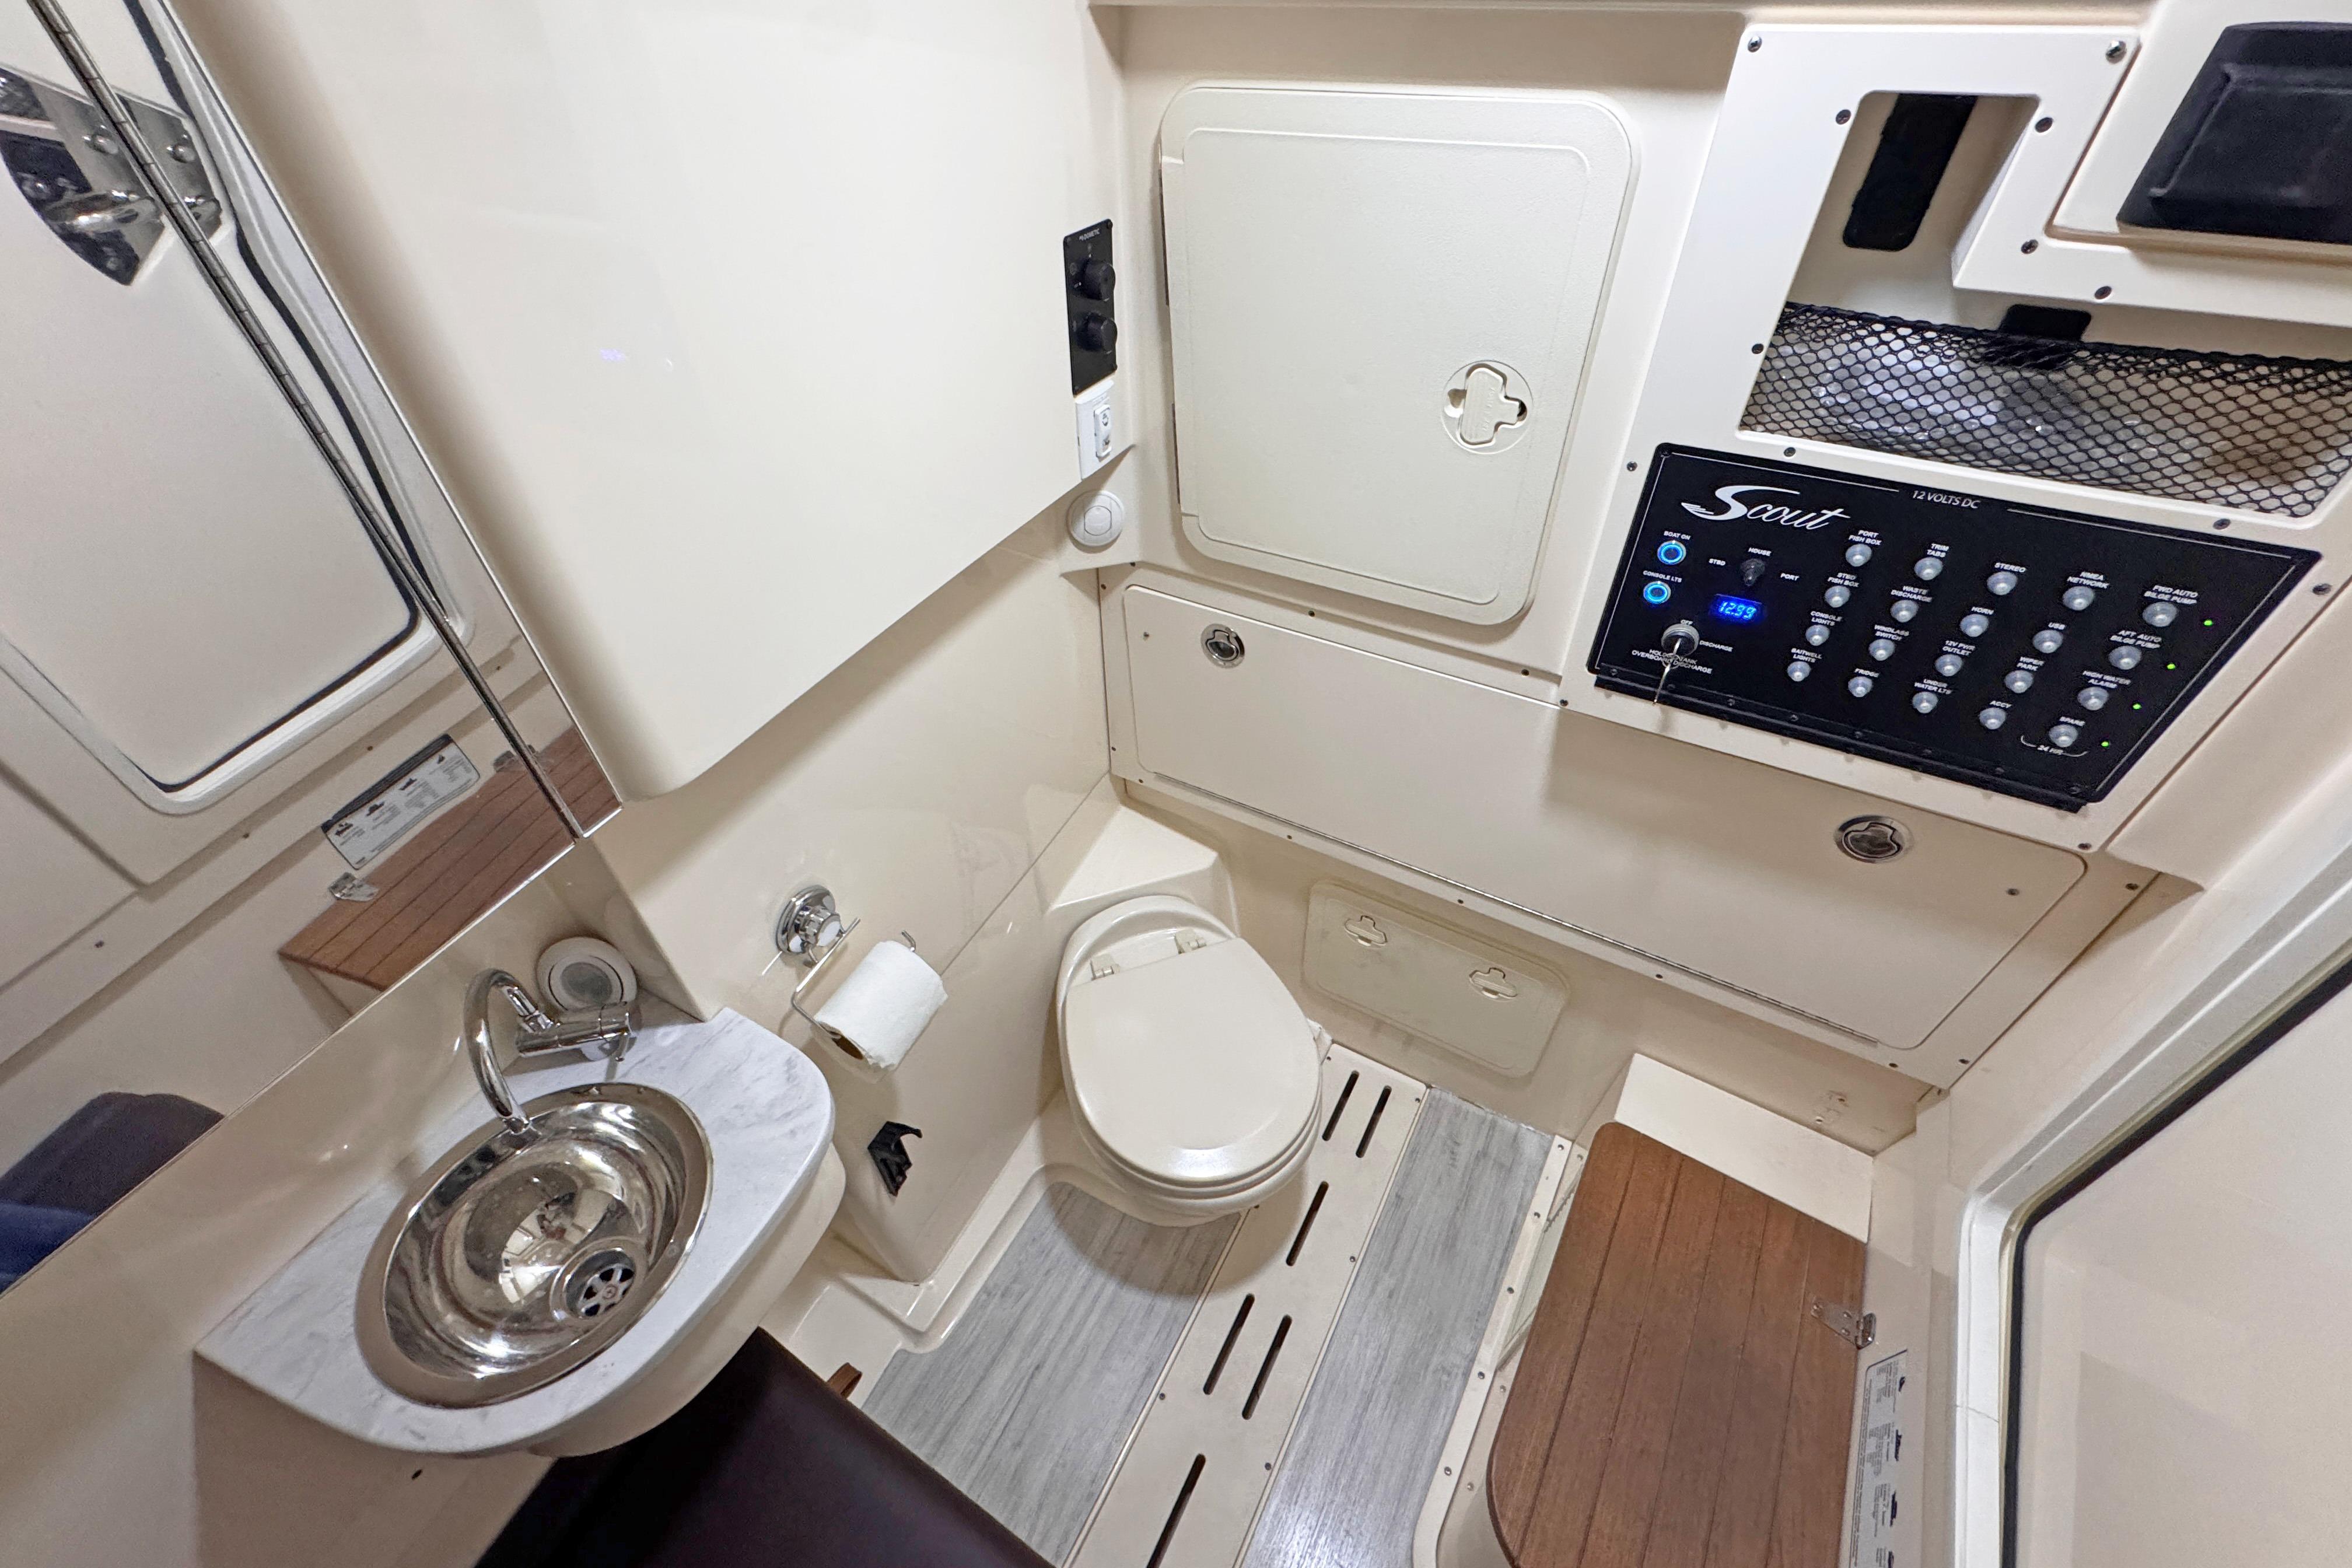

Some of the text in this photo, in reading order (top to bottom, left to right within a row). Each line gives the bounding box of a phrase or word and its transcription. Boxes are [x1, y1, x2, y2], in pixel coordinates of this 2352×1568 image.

[1912, 489, 1981, 509] 12 VOLTS DC
[1681, 485, 1852, 530] Scout
[1664, 530, 1680, 539] BOAT
[1858, 530, 1880, 538] PORT
[1748, 547, 1772, 556] HOUSE
[1931, 543, 1950, 551] TRIM
[1927, 549, 1947, 558] TABS
[1709, 558, 1726, 566] STBD
[1994, 562, 2027, 573] STEREO
[1643, 570, 1671, 581] CONSOLE
[1780, 572, 1799, 582] PORT
[1837, 572, 1857, 580] STBD
[2067, 576, 2110, 589] NETWORK
[1902, 586, 1929, 594] WASTE
[2152, 584, 2199, 598] FWD AUTO
[1891, 590, 1933, 603] DISCHARGE
[2144, 590, 2197, 605] BILGE PUMP
[1718, 601, 1756, 620] 12.99
[1971, 606, 1994, 615] HORN
[1811, 611, 1843, 622] CONSOLE
[1811, 618, 1835, 626] LIGHTS
[2048, 622, 2066, 630] USB
[1874, 625, 1910, 636] WINDLASS
[1875, 631, 1902, 641] SWITCH
[2137, 634, 2162, 642] AUTO
[1699, 640, 1733, 652] DISCHARGE
[1957, 642, 1976, 650] PWR
[2109, 635, 2160, 649] BILGE PUMP
[1791, 648, 1822, 659] BAITWELL
[1942, 646, 1972, 656] OUTLET
[1793, 653, 1817, 663] LIGHTS
[2020, 656, 2046, 666] WIPER
[1673, 660, 1713, 674] DISCHARGE
[2017, 663, 2039, 671] PARK
[1855, 668, 1880, 678] FRIDGE
[1914, 682, 1938, 692] WATER
[1923, 678, 1948, 688] UNDER
[1989, 700, 2012, 709] ACCY
